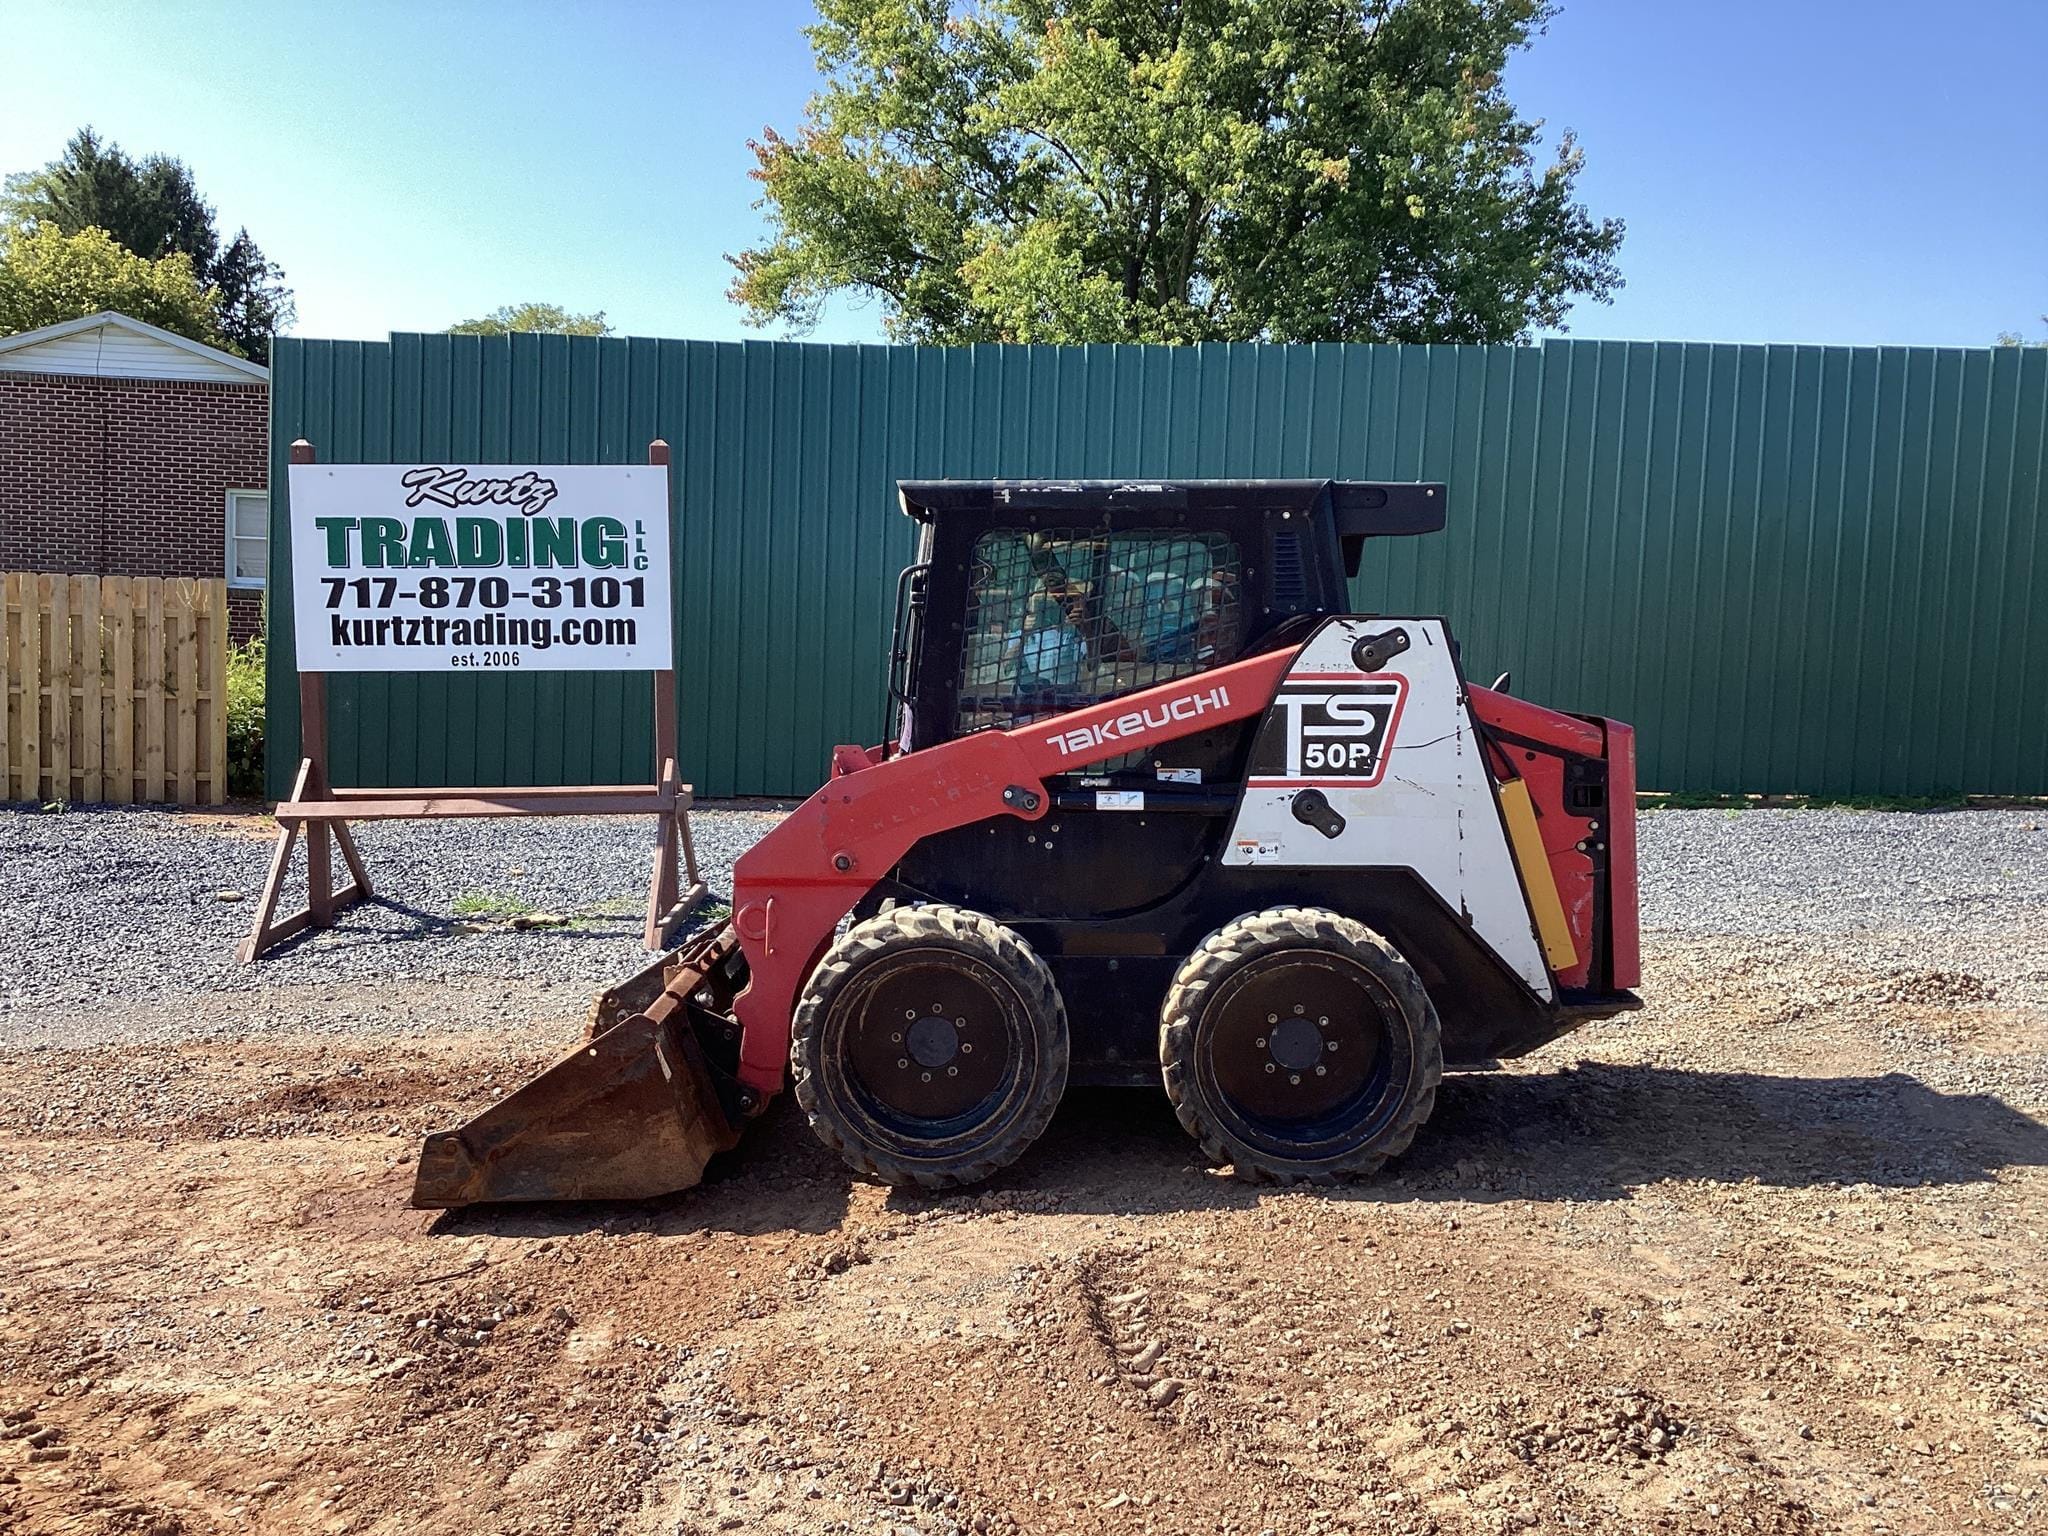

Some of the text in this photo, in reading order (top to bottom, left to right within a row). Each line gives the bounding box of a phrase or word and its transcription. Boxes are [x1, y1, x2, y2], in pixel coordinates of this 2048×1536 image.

[401, 467, 558, 515] Kurtz
[315, 516, 628, 569] TRADING
[633, 519, 649, 571] LLC
[320, 576, 645, 609] 717-870-3101
[331, 613, 636, 649] kurtztrading.com
[451, 651, 520, 667] est. 2006
[1273, 693, 1398, 776] TS
